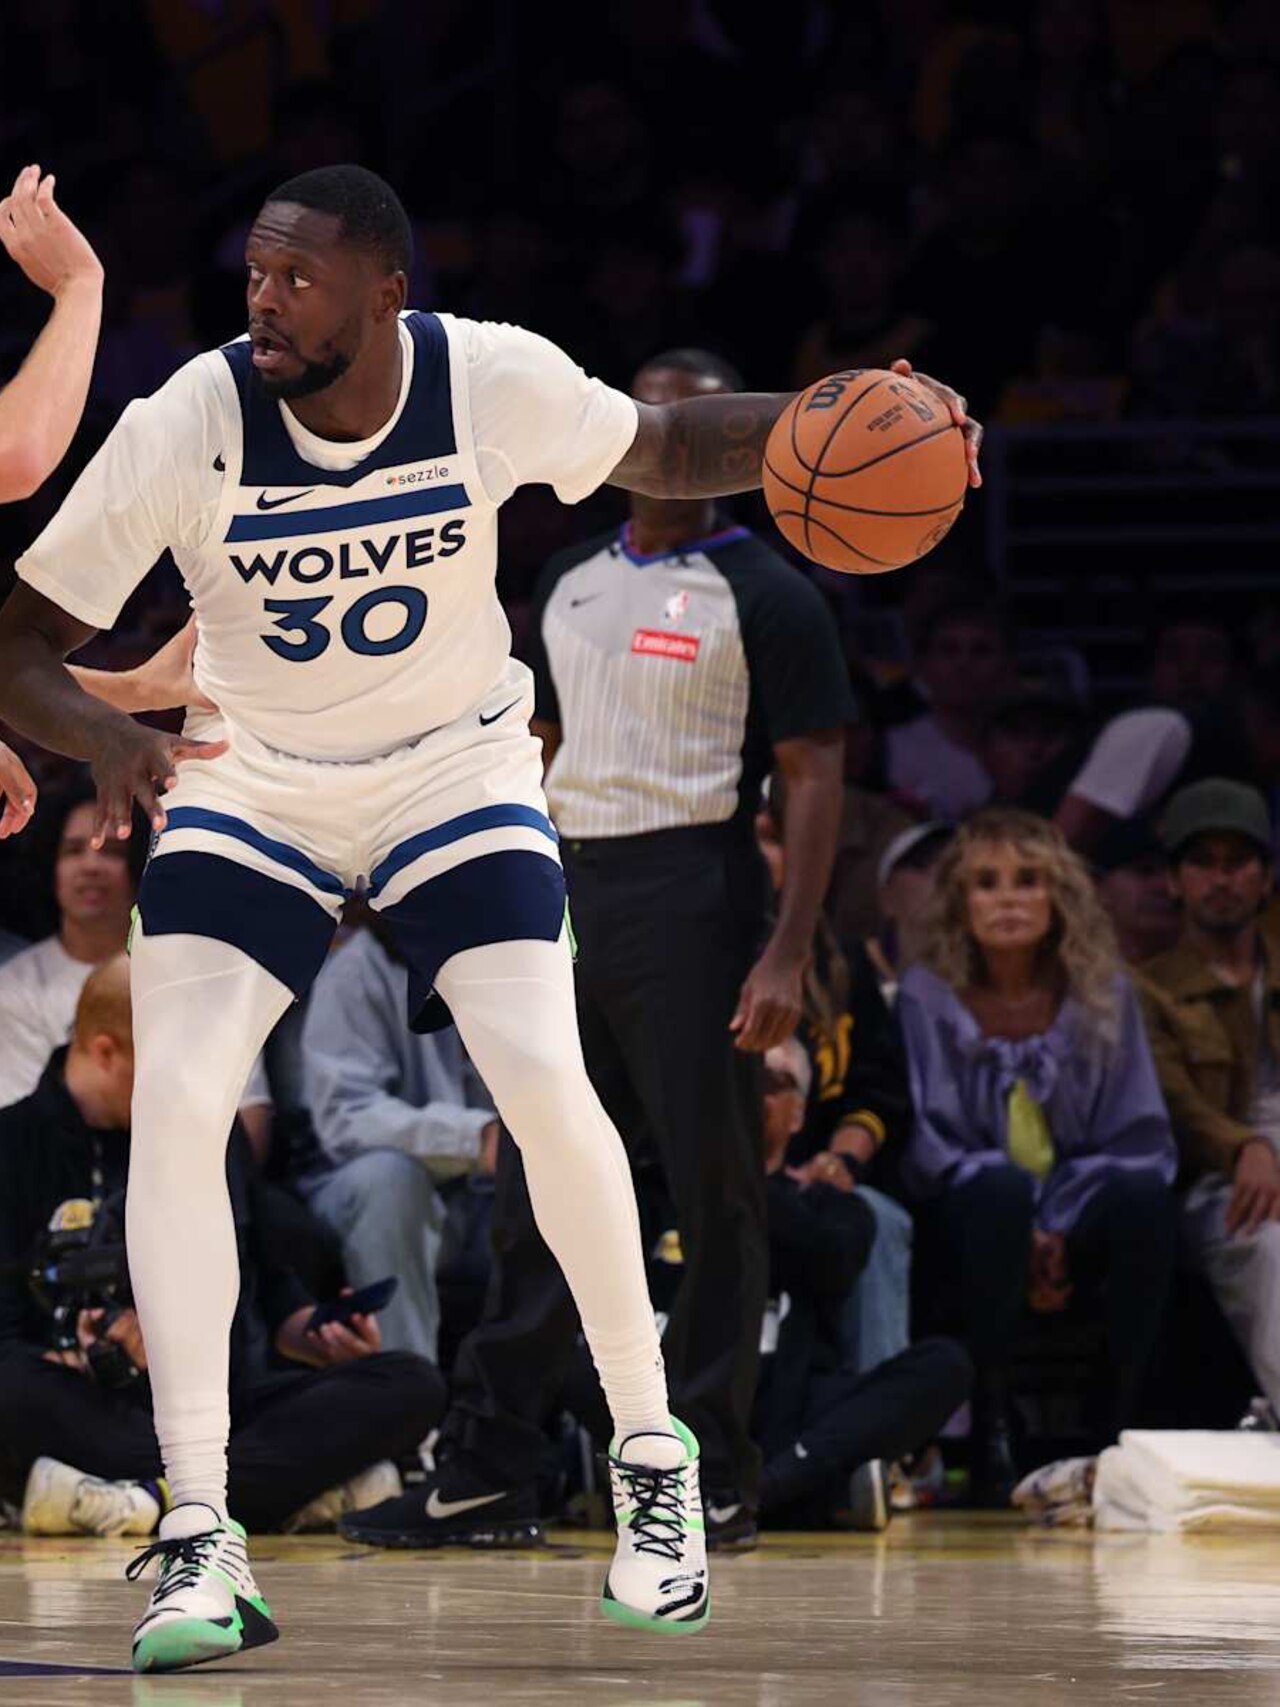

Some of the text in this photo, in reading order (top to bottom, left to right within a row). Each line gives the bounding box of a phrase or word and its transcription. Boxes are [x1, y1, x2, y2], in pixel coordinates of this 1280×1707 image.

[398, 465, 449, 486] sezzle
[229, 519, 467, 586] WOLVES
[260, 585, 429, 662] 30
